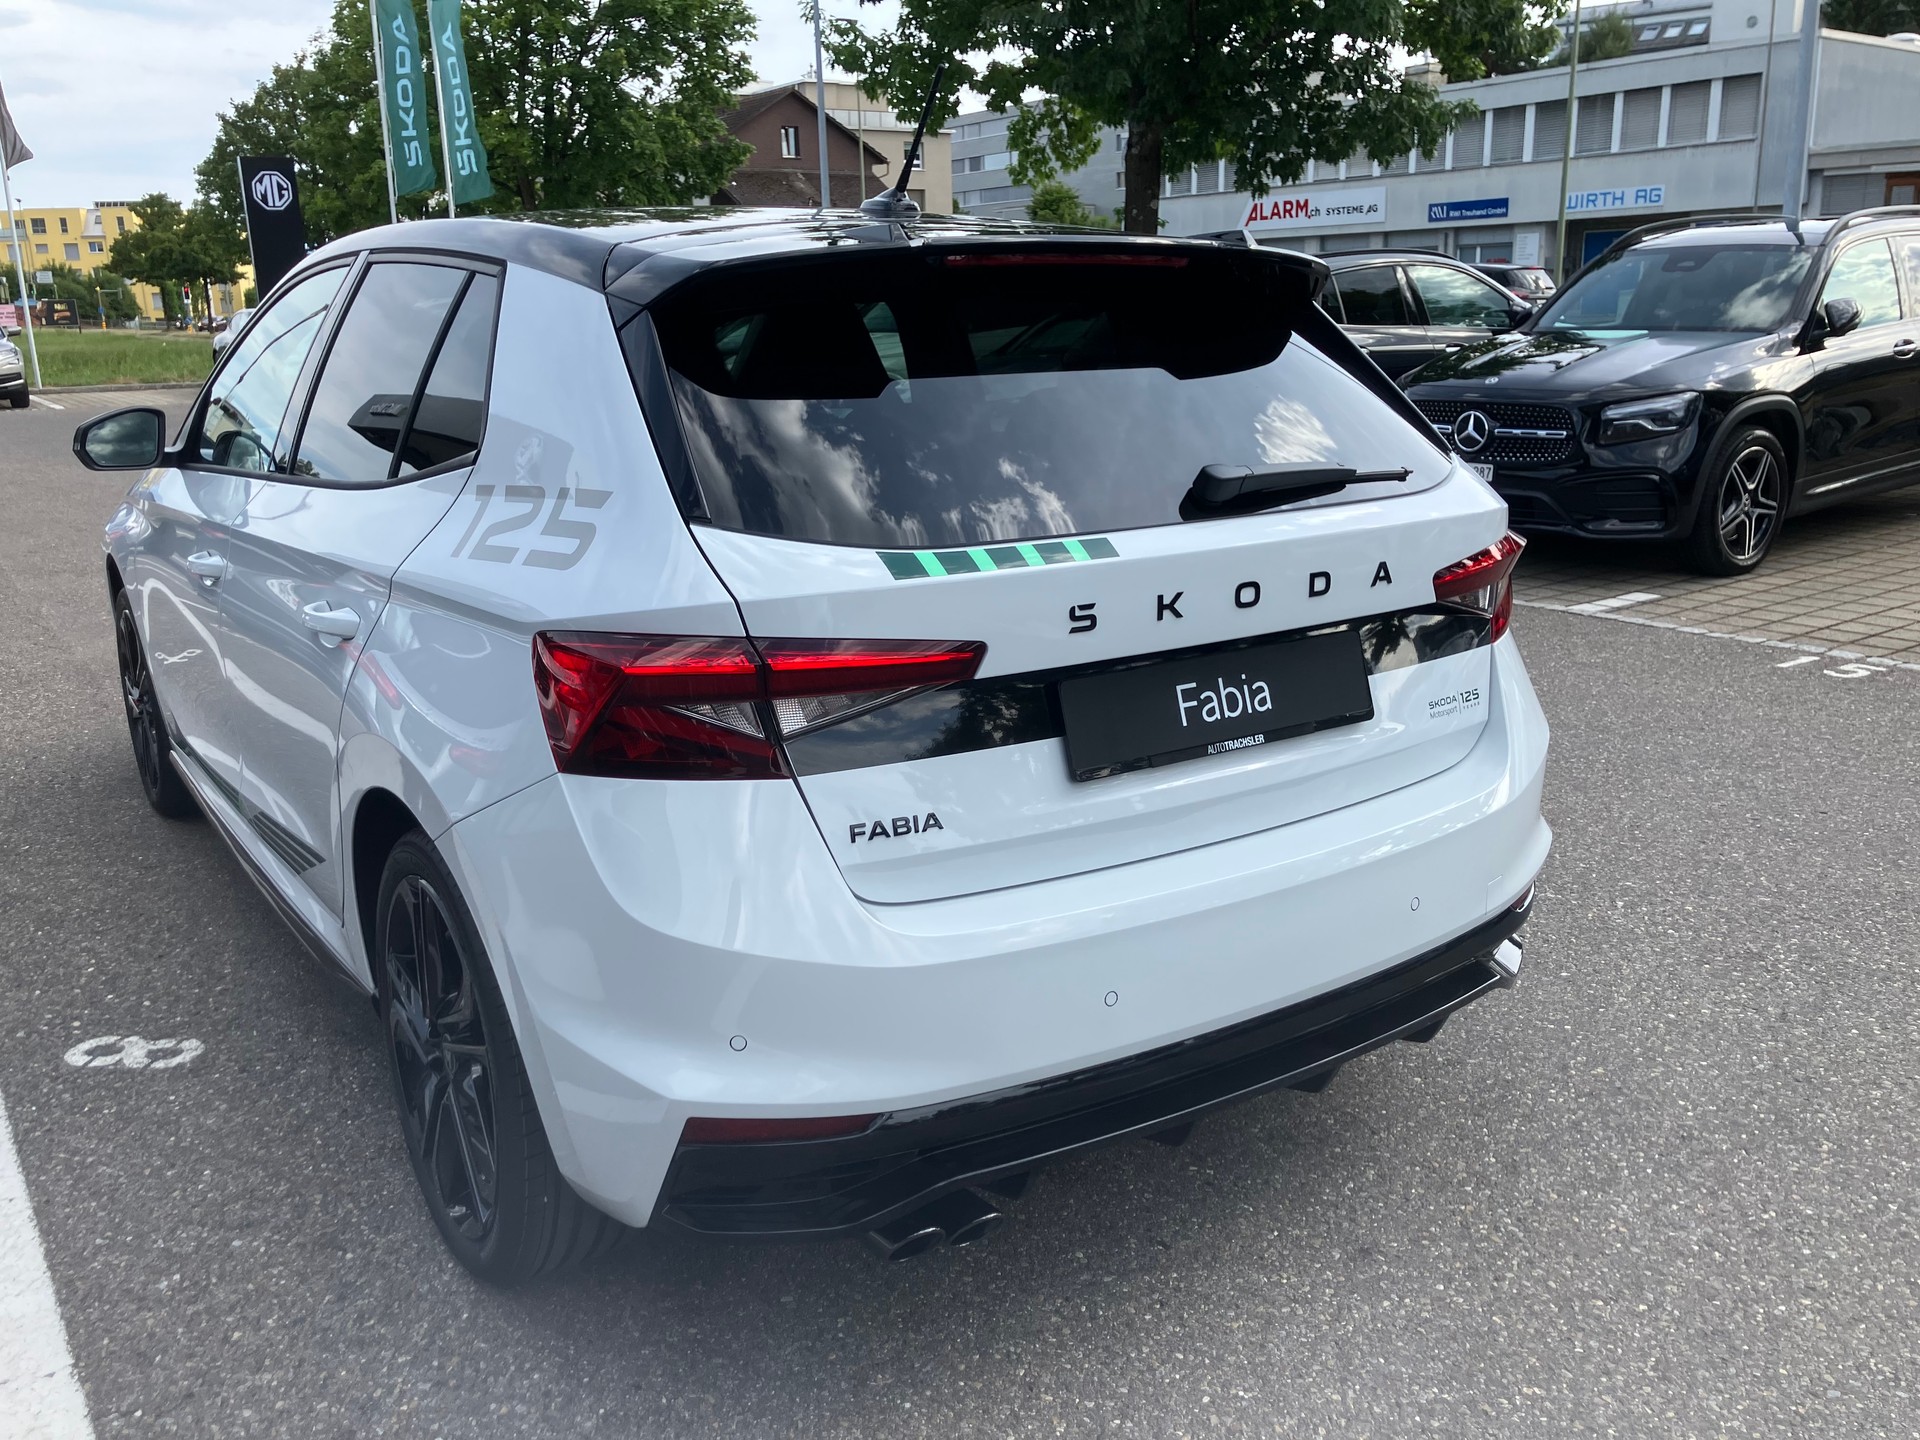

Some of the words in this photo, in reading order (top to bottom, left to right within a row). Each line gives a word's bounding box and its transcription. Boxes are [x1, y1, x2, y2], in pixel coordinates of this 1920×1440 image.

[255, 174, 289, 207] MG
[1635, 187, 1662, 204] AG
[1326, 205, 1364, 216] SYSTEME
[1365, 203, 1378, 216] AG
[1462, 208, 1487, 217] Treuhand
[1487, 206, 1507, 215] GmbH
[450, 484, 614, 571] 125
[1068, 561, 1393, 635] SKODA
[1175, 673, 1272, 727] Fabia
[1428, 695, 1457, 710] SKODA
[1460, 688, 1480, 704] 125
[1429, 706, 1458, 719] Motorsport
[1207, 733, 1265, 755] AUTOTRACHSLER
[849, 812, 944, 844] FABIA
